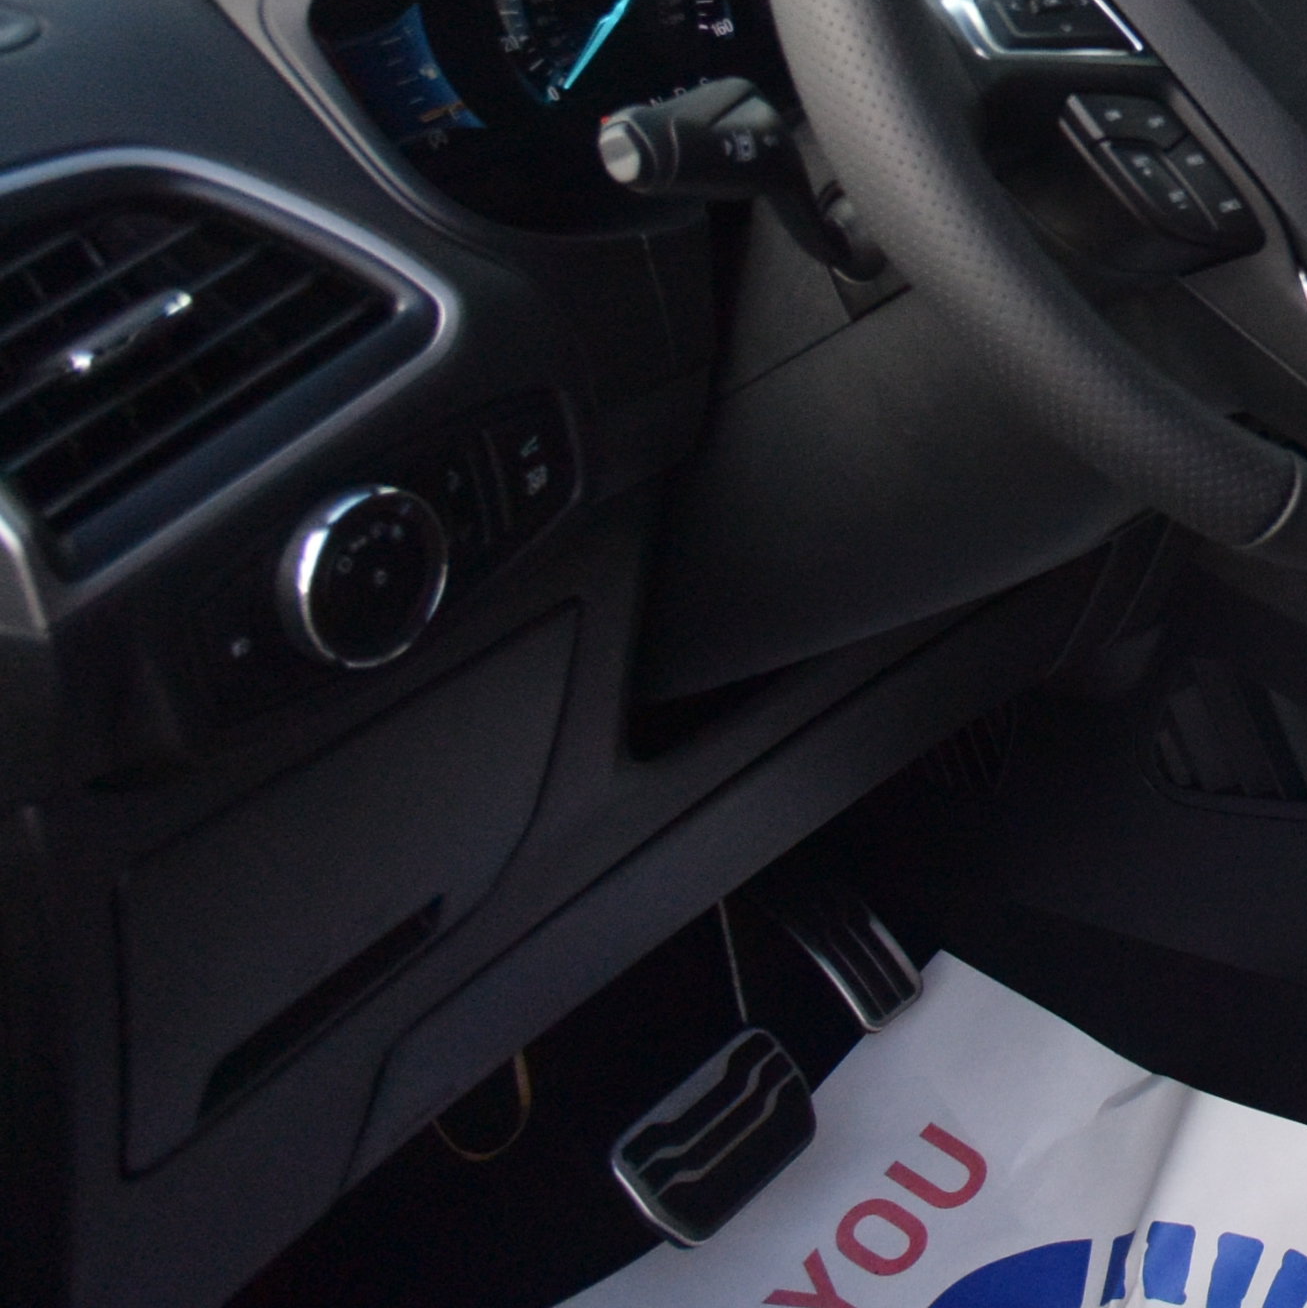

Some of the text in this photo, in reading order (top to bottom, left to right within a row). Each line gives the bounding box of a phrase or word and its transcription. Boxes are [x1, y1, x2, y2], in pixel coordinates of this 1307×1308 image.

[711, 19, 734, 37] 160
[500, 36, 520, 53] 20
[546, 86, 560, 101] 0
[762, 1121, 988, 1308] YOU
